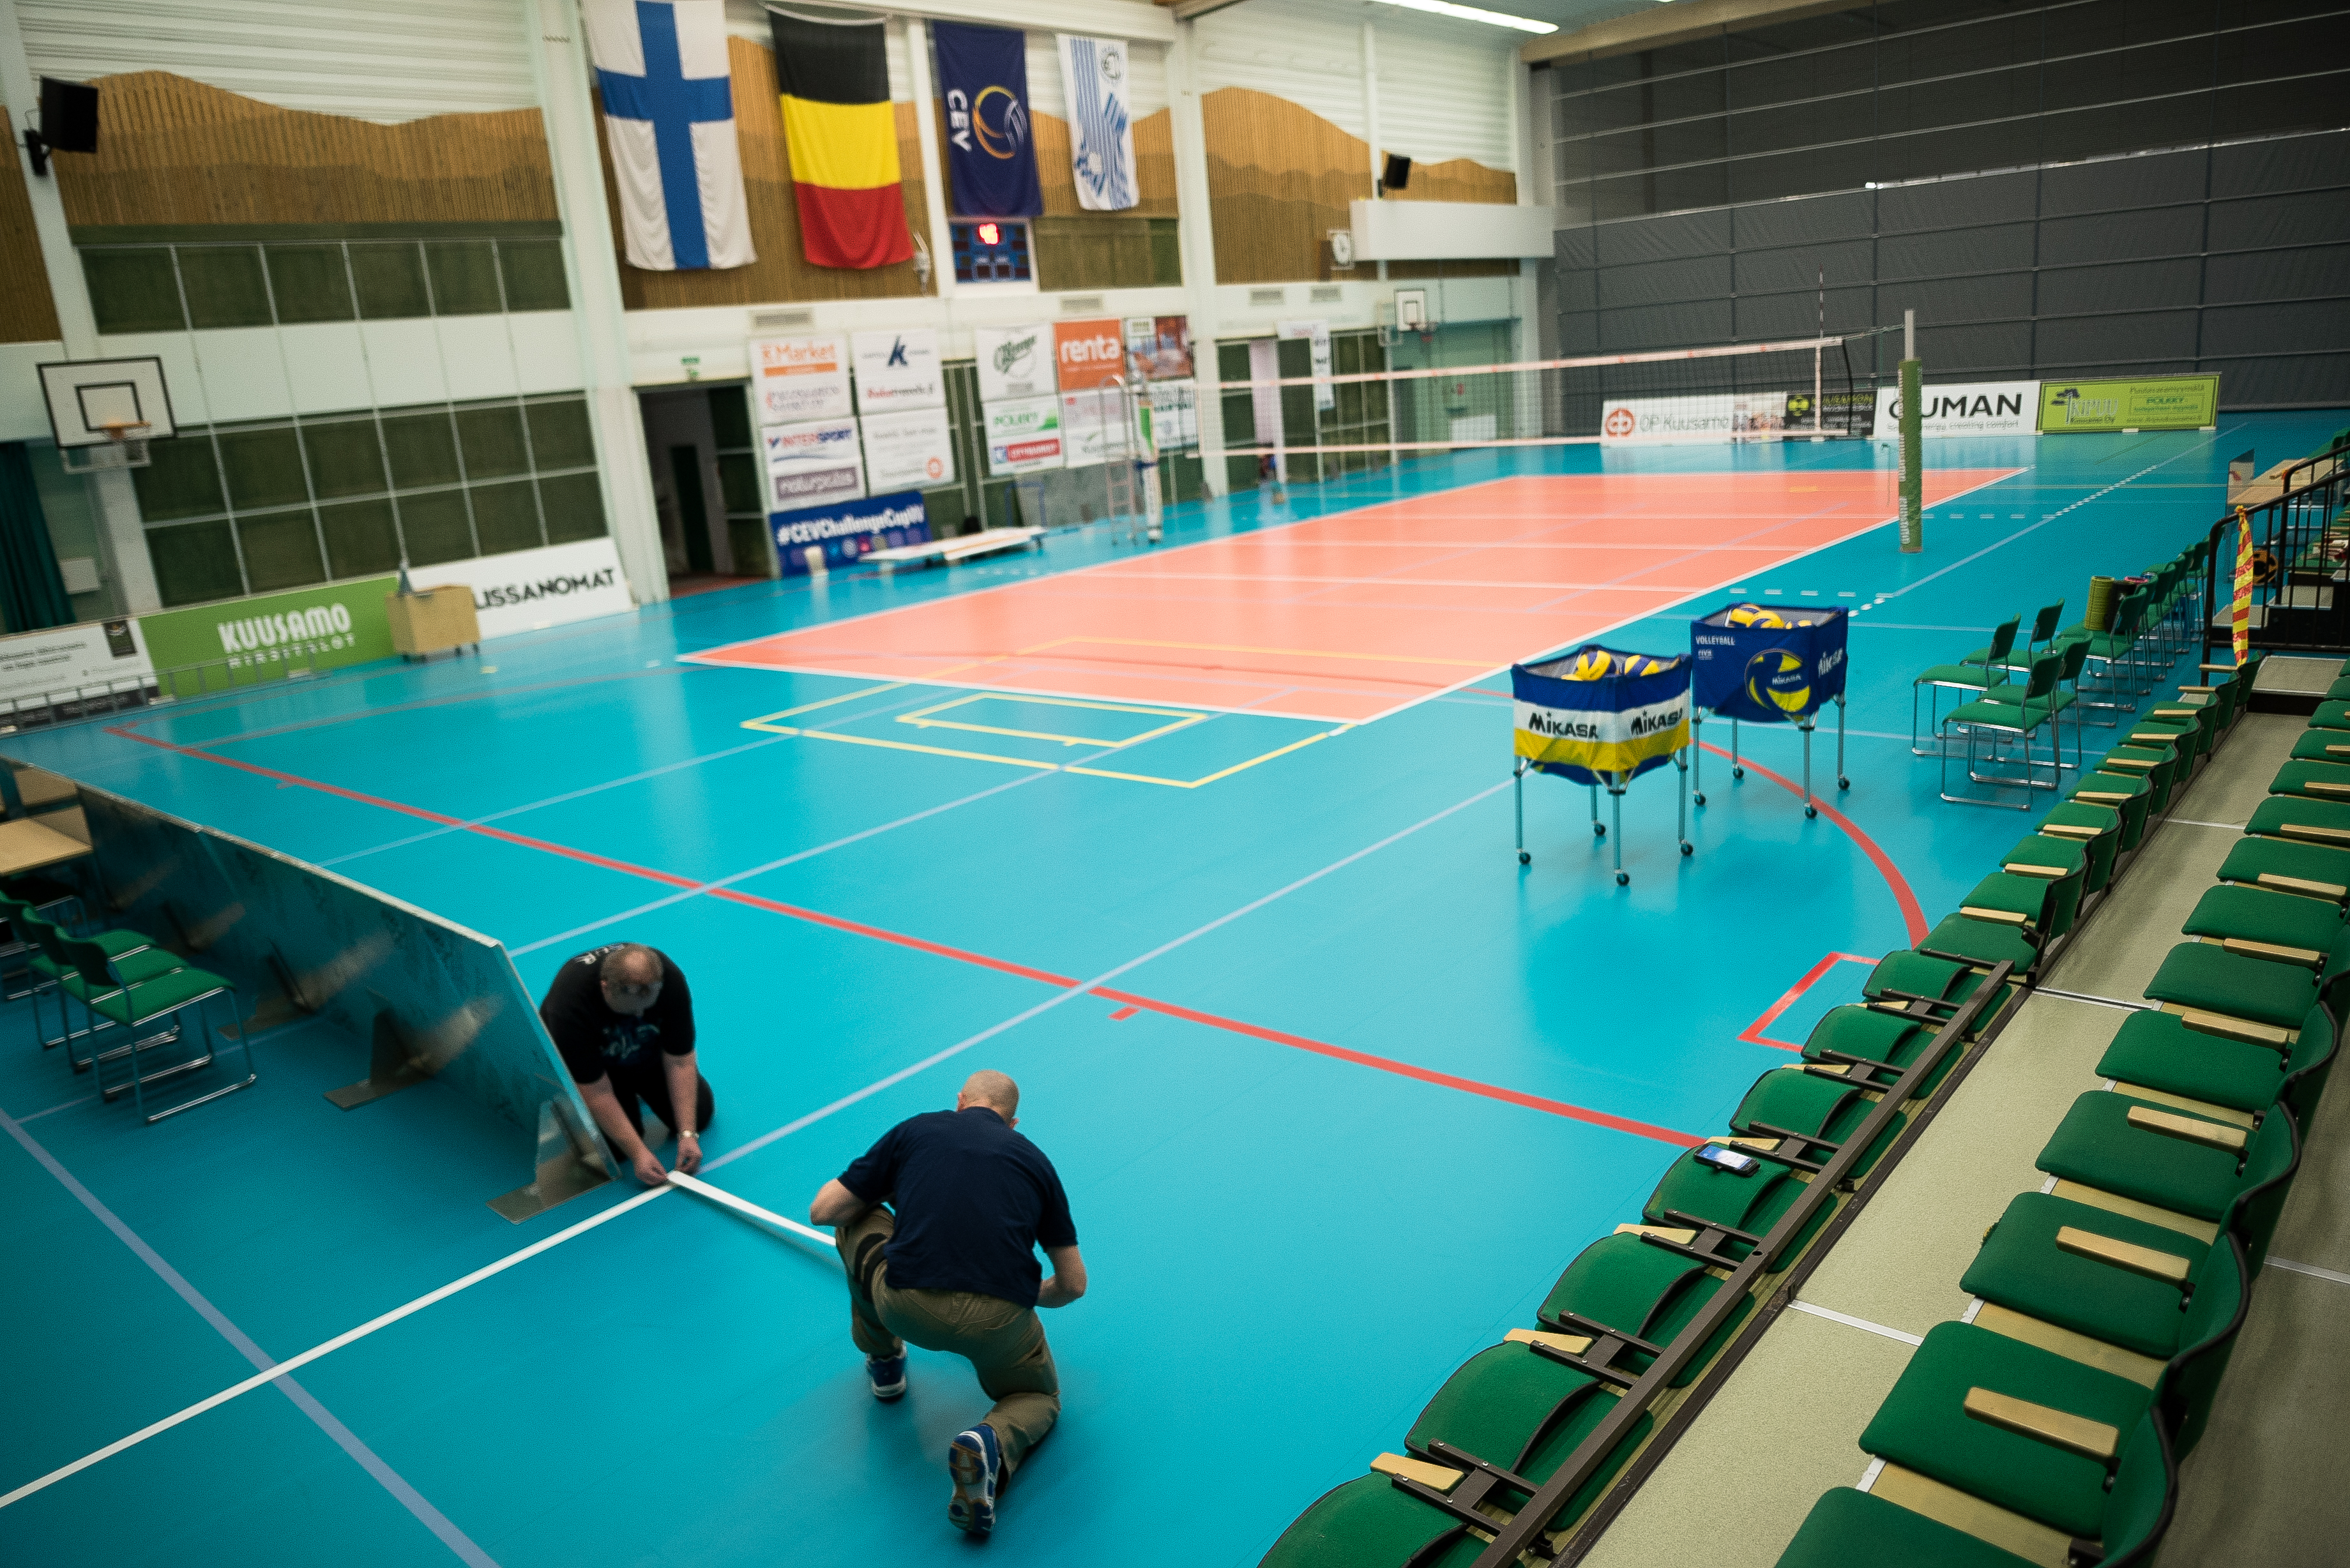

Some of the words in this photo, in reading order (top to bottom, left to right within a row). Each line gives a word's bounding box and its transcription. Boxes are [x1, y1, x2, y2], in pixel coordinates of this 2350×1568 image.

[947, 88, 973, 152] CEV
[1060, 334, 1121, 365] renta
[1662, 412, 1730, 432] Kuusamo
[217, 602, 351, 654] KUUSAMO
[1695, 635, 1736, 646] VOLLEYBALL
